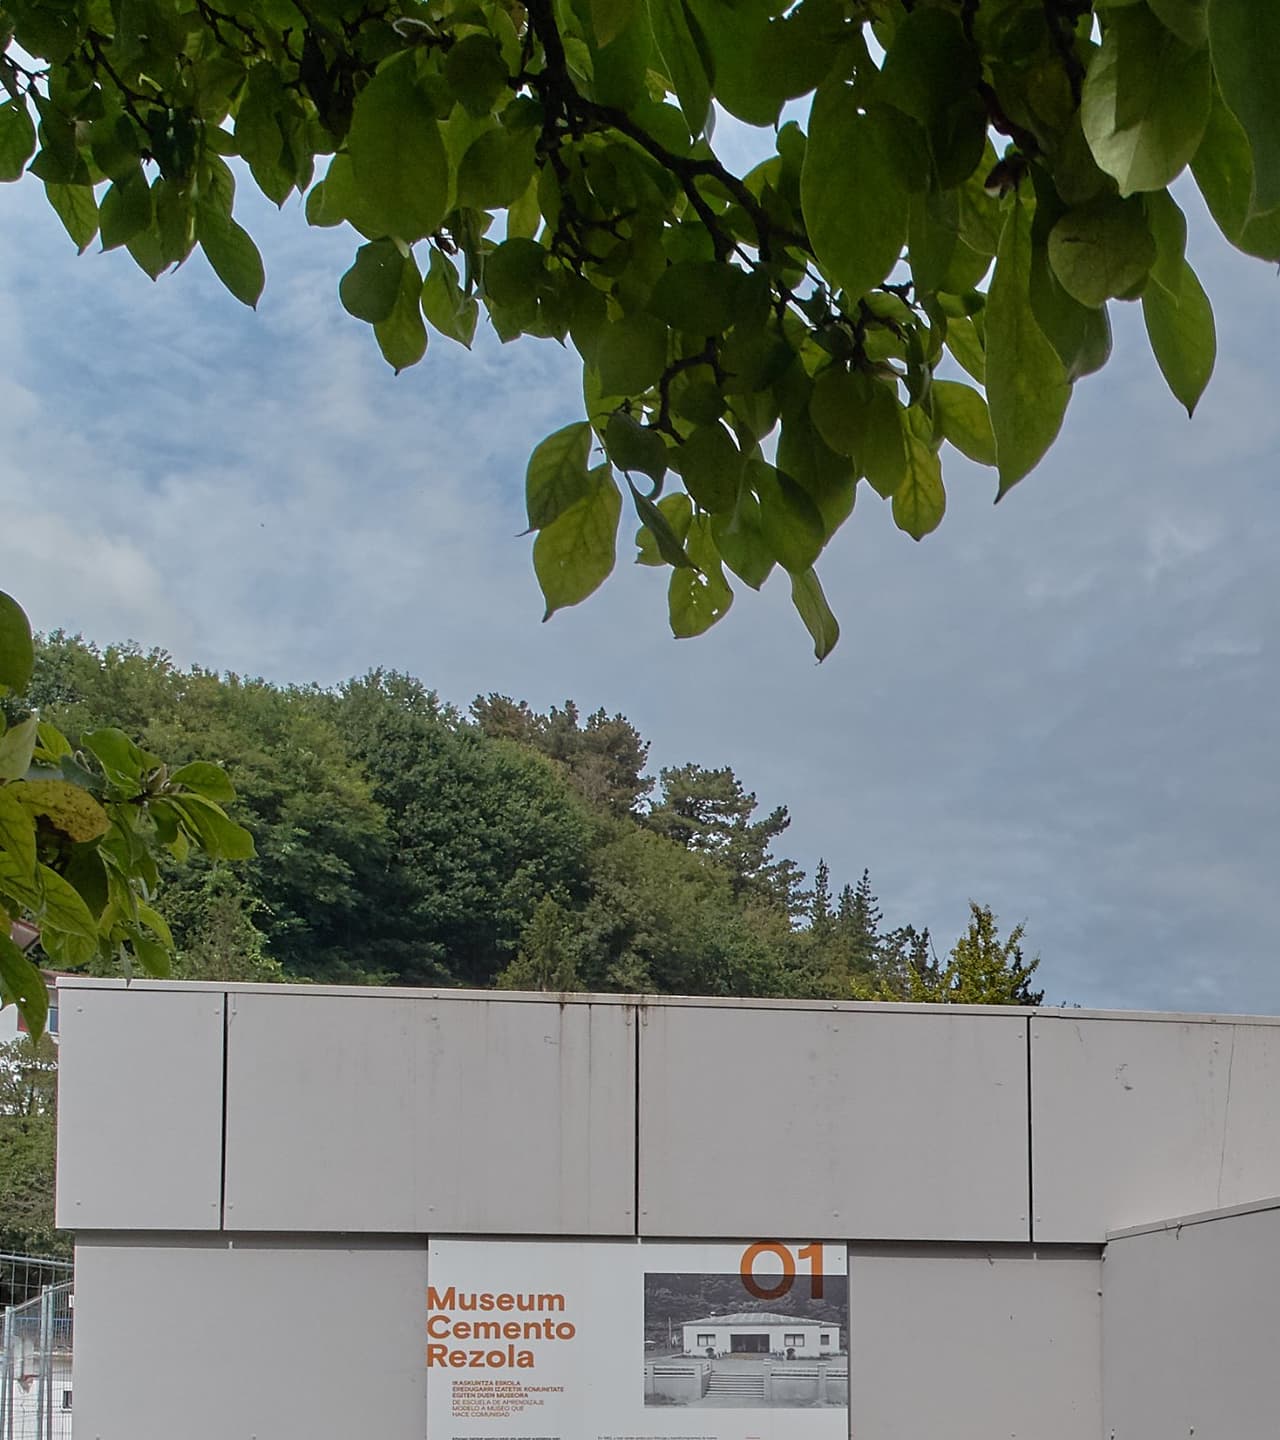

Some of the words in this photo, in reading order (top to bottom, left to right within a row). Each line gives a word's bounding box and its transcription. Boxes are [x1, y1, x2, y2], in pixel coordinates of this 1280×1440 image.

[426, 1286, 566, 1312] Museum
[426, 1314, 577, 1341] Cemento
[426, 1343, 535, 1369] Rezola
